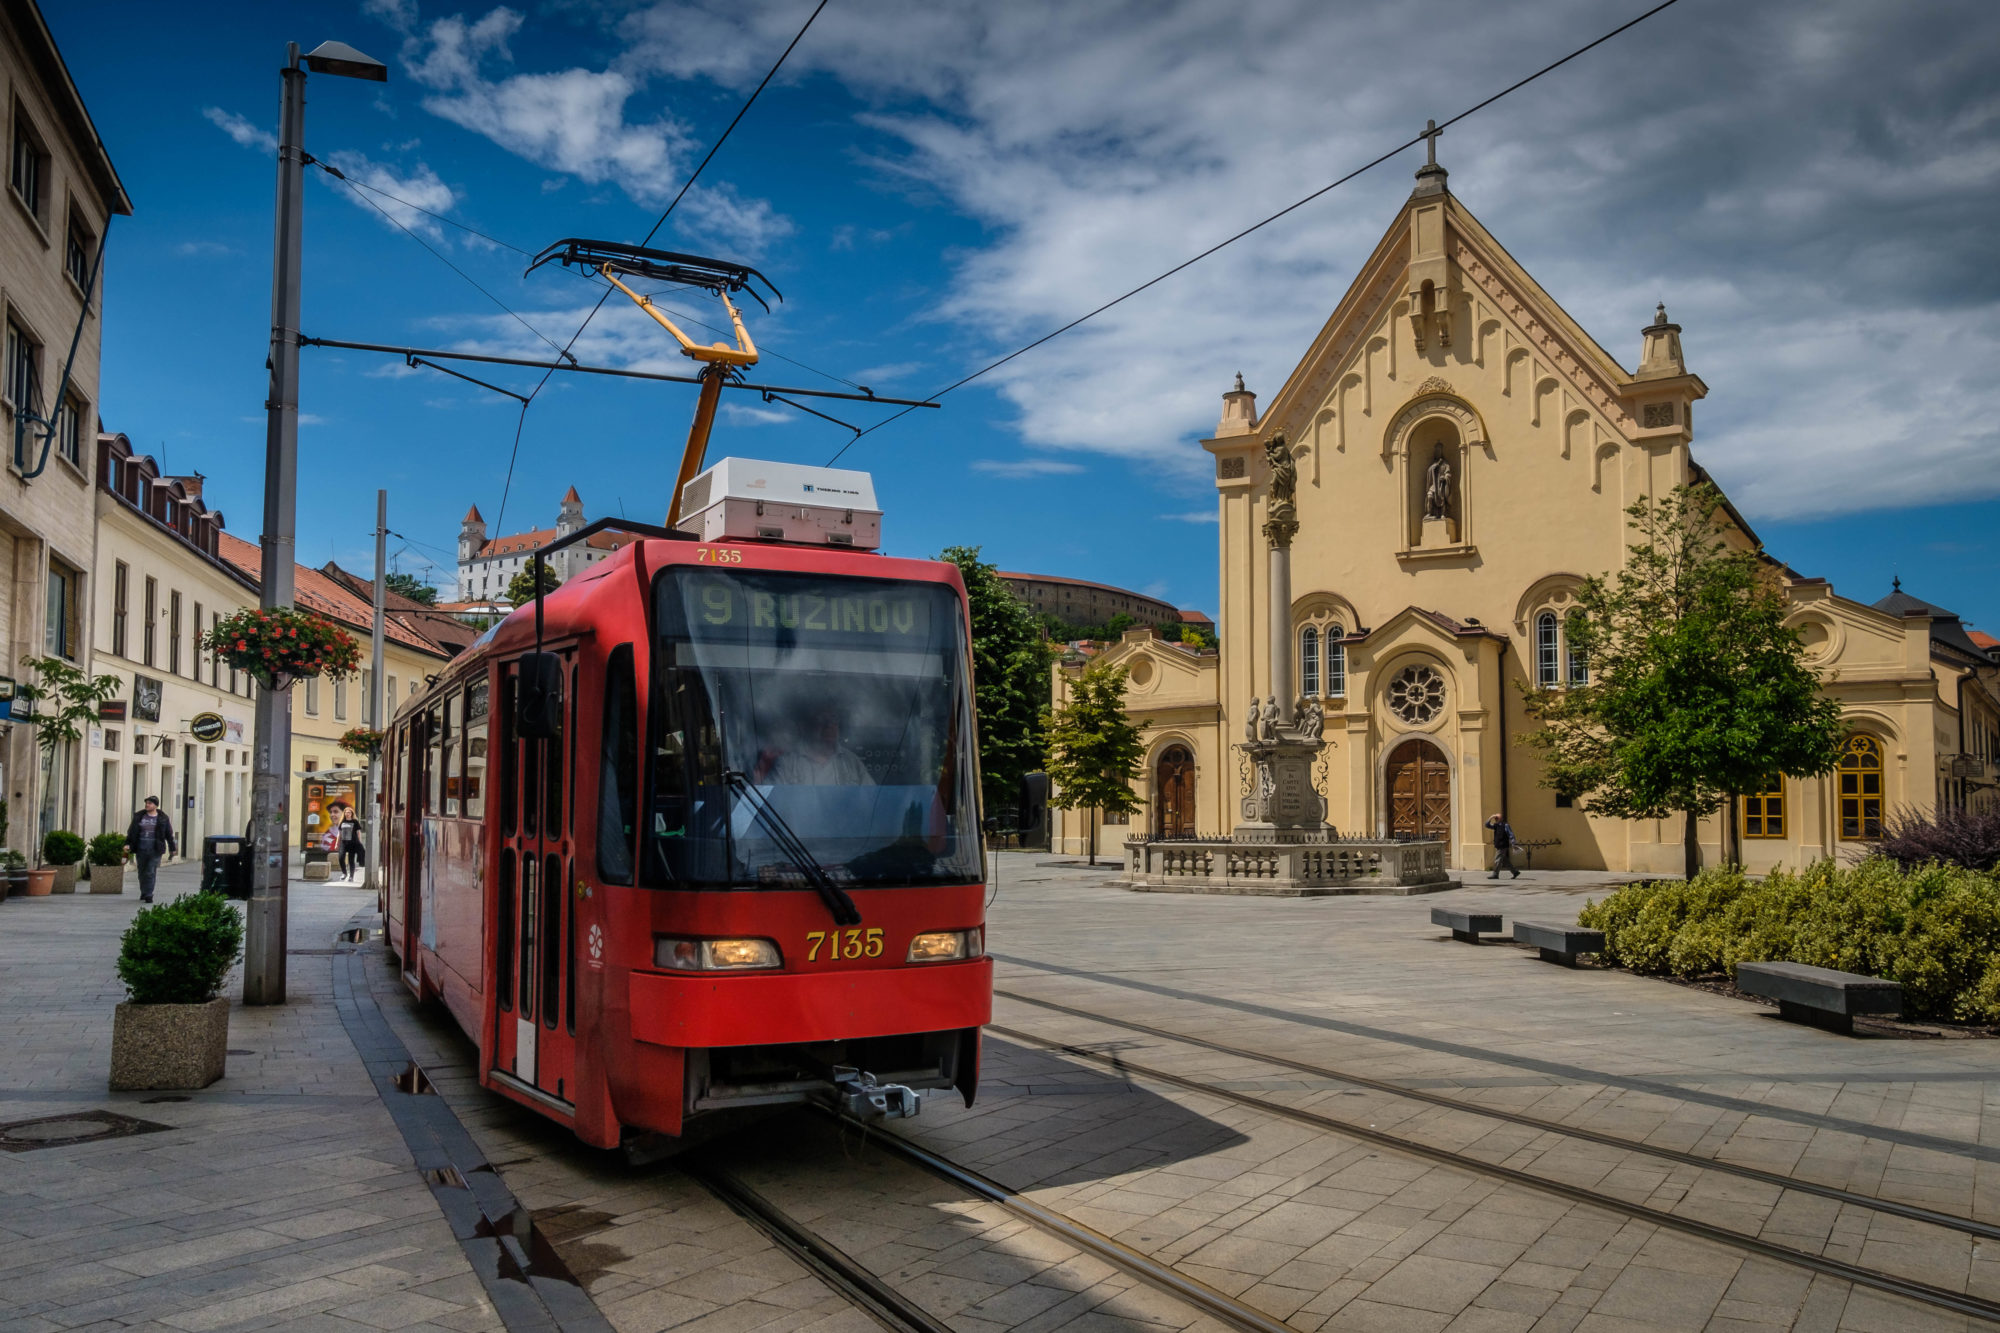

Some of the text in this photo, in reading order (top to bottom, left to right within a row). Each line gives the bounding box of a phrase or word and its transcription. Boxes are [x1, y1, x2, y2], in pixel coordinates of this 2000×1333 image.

[696, 548, 742, 563] 7135
[702, 584, 732, 625] 9
[806, 928, 884, 962] 7135
